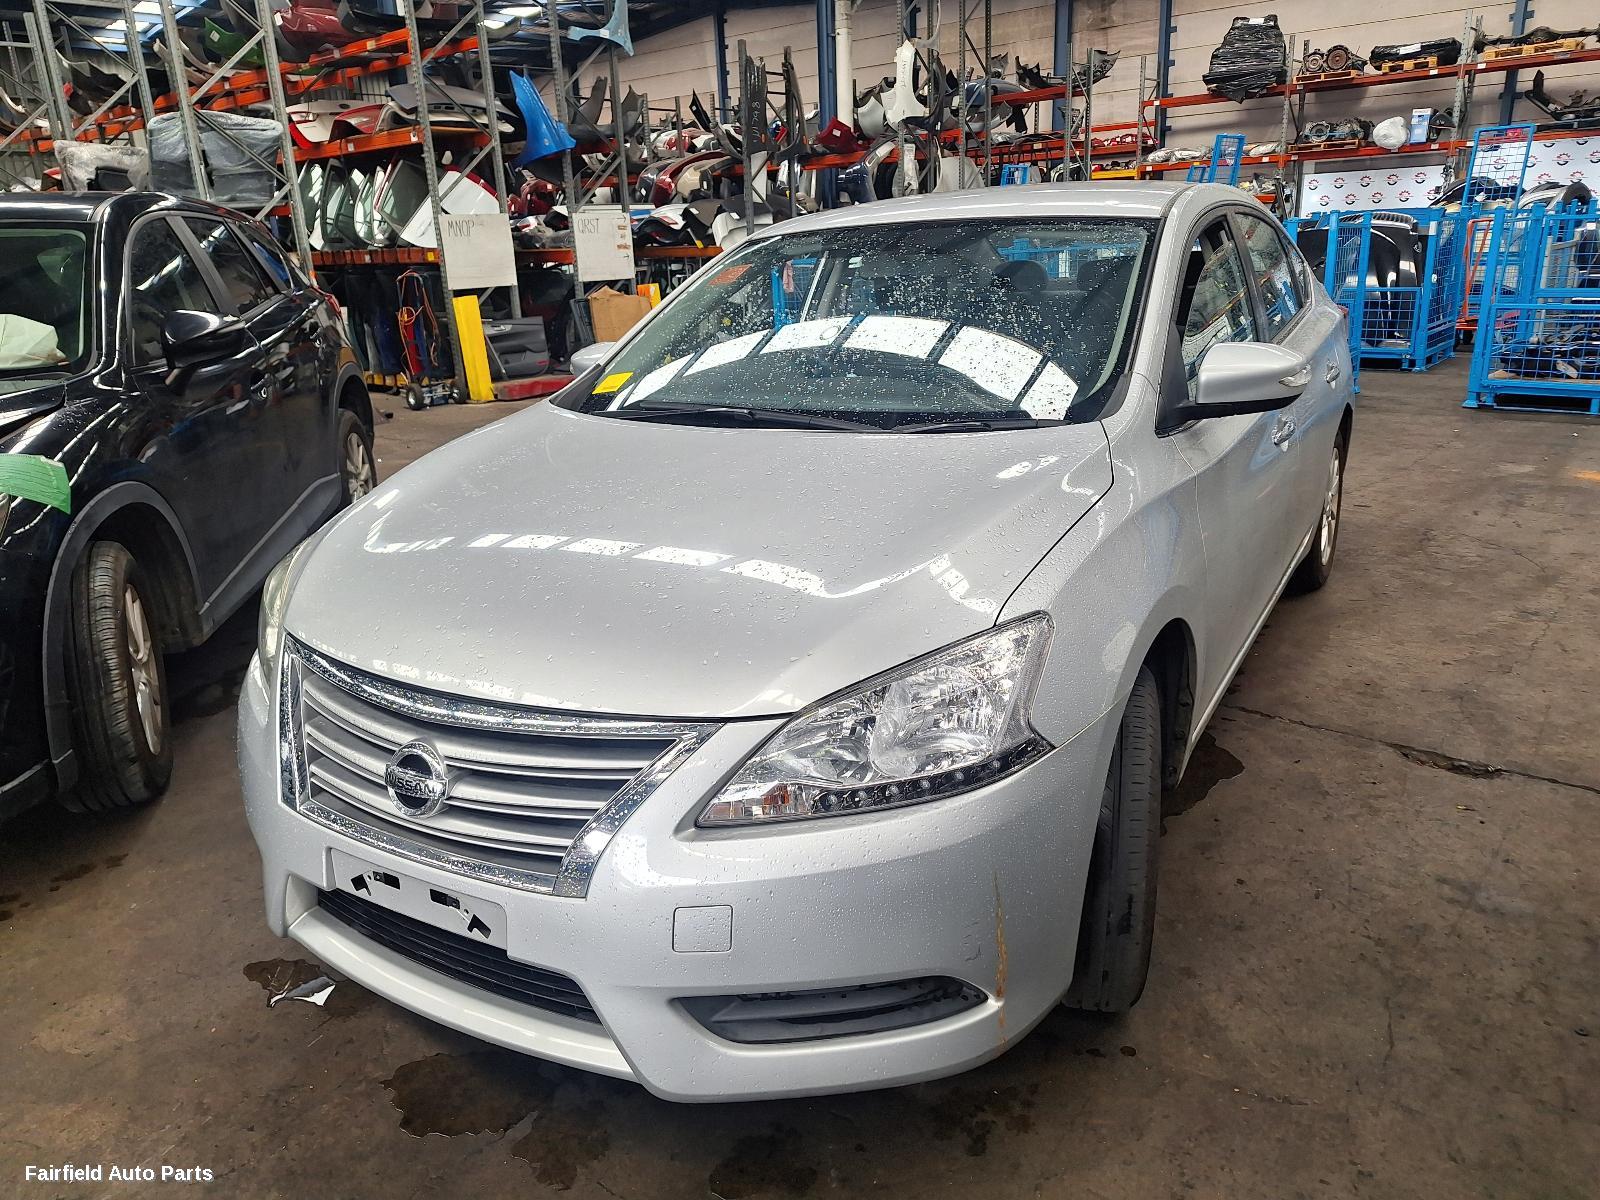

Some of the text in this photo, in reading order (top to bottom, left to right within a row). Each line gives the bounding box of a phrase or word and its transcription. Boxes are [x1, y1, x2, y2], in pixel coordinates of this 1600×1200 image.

[447, 219, 475, 237] MNOP
[577, 217, 600, 234] QRST
[385, 766, 437, 796] NISSAN
